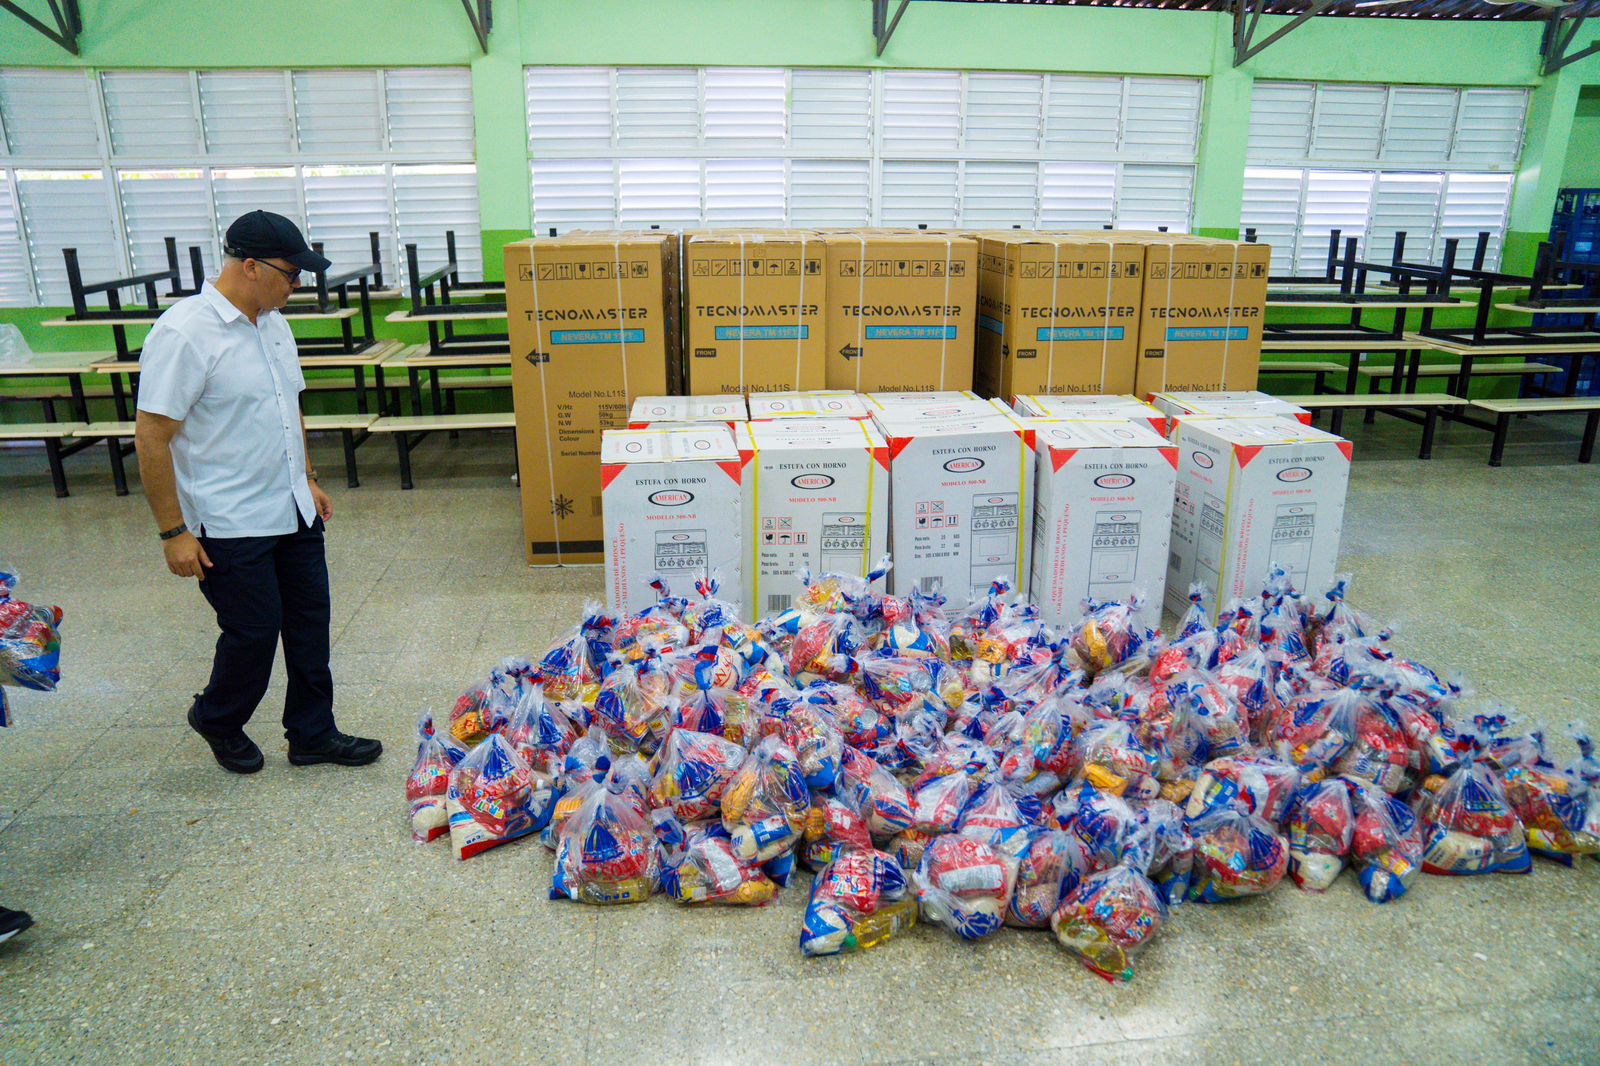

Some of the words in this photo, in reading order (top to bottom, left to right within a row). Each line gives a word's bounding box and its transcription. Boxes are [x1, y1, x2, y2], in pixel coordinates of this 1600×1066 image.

[789, 261, 795, 269] 2
[934, 262, 941, 271] 2
[1111, 264, 1117, 272] 2
[525, 308, 648, 321] TECNOMASTER
[696, 305, 818, 316] TECNOMASTER
[842, 305, 961, 316] TECNOMASTER
[1021, 306, 1135, 318] TECNOMASTER
[1150, 307, 1259, 318] TECNOMASTER
[726, 329, 761, 337] NEVERA
[876, 329, 910, 337] NEVERA
[1047, 330, 1080, 338] NEVERA
[561, 333, 597, 342] NEVERA
[721, 384, 748, 393] Model
[1038, 385, 1065, 393] Model
[1164, 384, 1189, 392] Model
[957, 446, 972, 454] CON
[949, 461, 979, 469] AMERICAN
